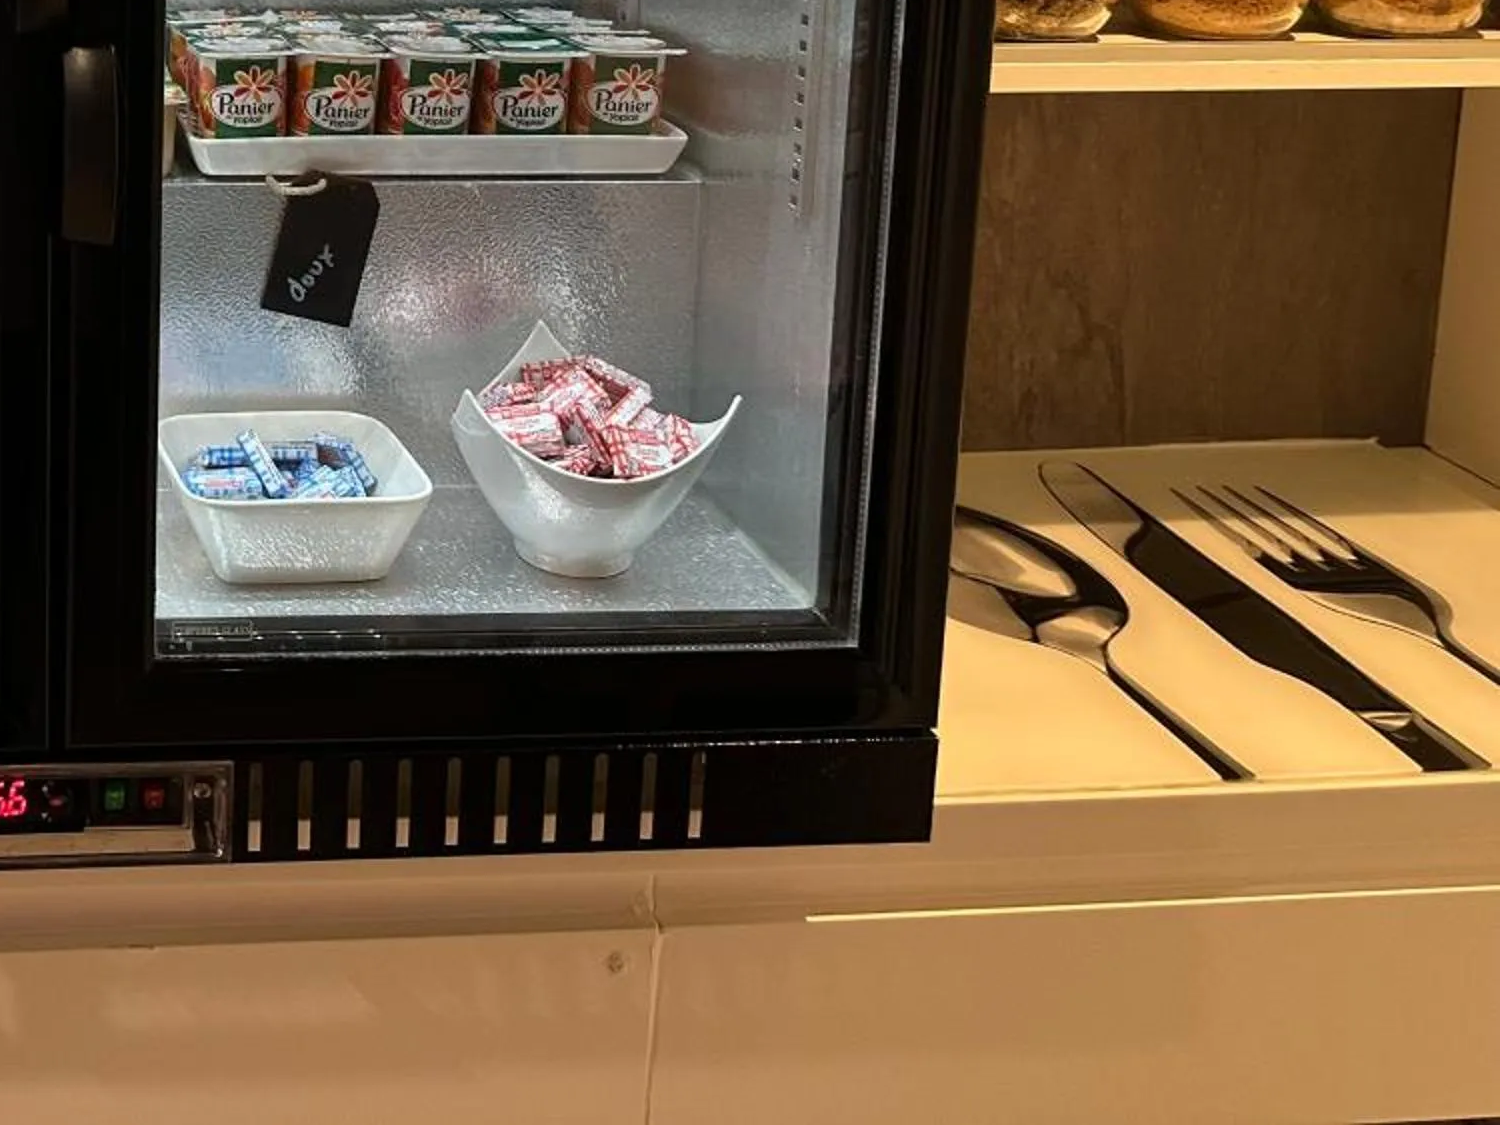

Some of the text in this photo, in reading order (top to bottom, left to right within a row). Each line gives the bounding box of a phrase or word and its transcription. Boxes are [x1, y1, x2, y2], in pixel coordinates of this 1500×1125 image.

[215, 92, 275, 116] Panier
[312, 94, 372, 119] Panier
[407, 94, 465, 117] Panier
[500, 94, 559, 119] Panier
[594, 88, 652, 112] Panier
[286, 243, 335, 303] doux
